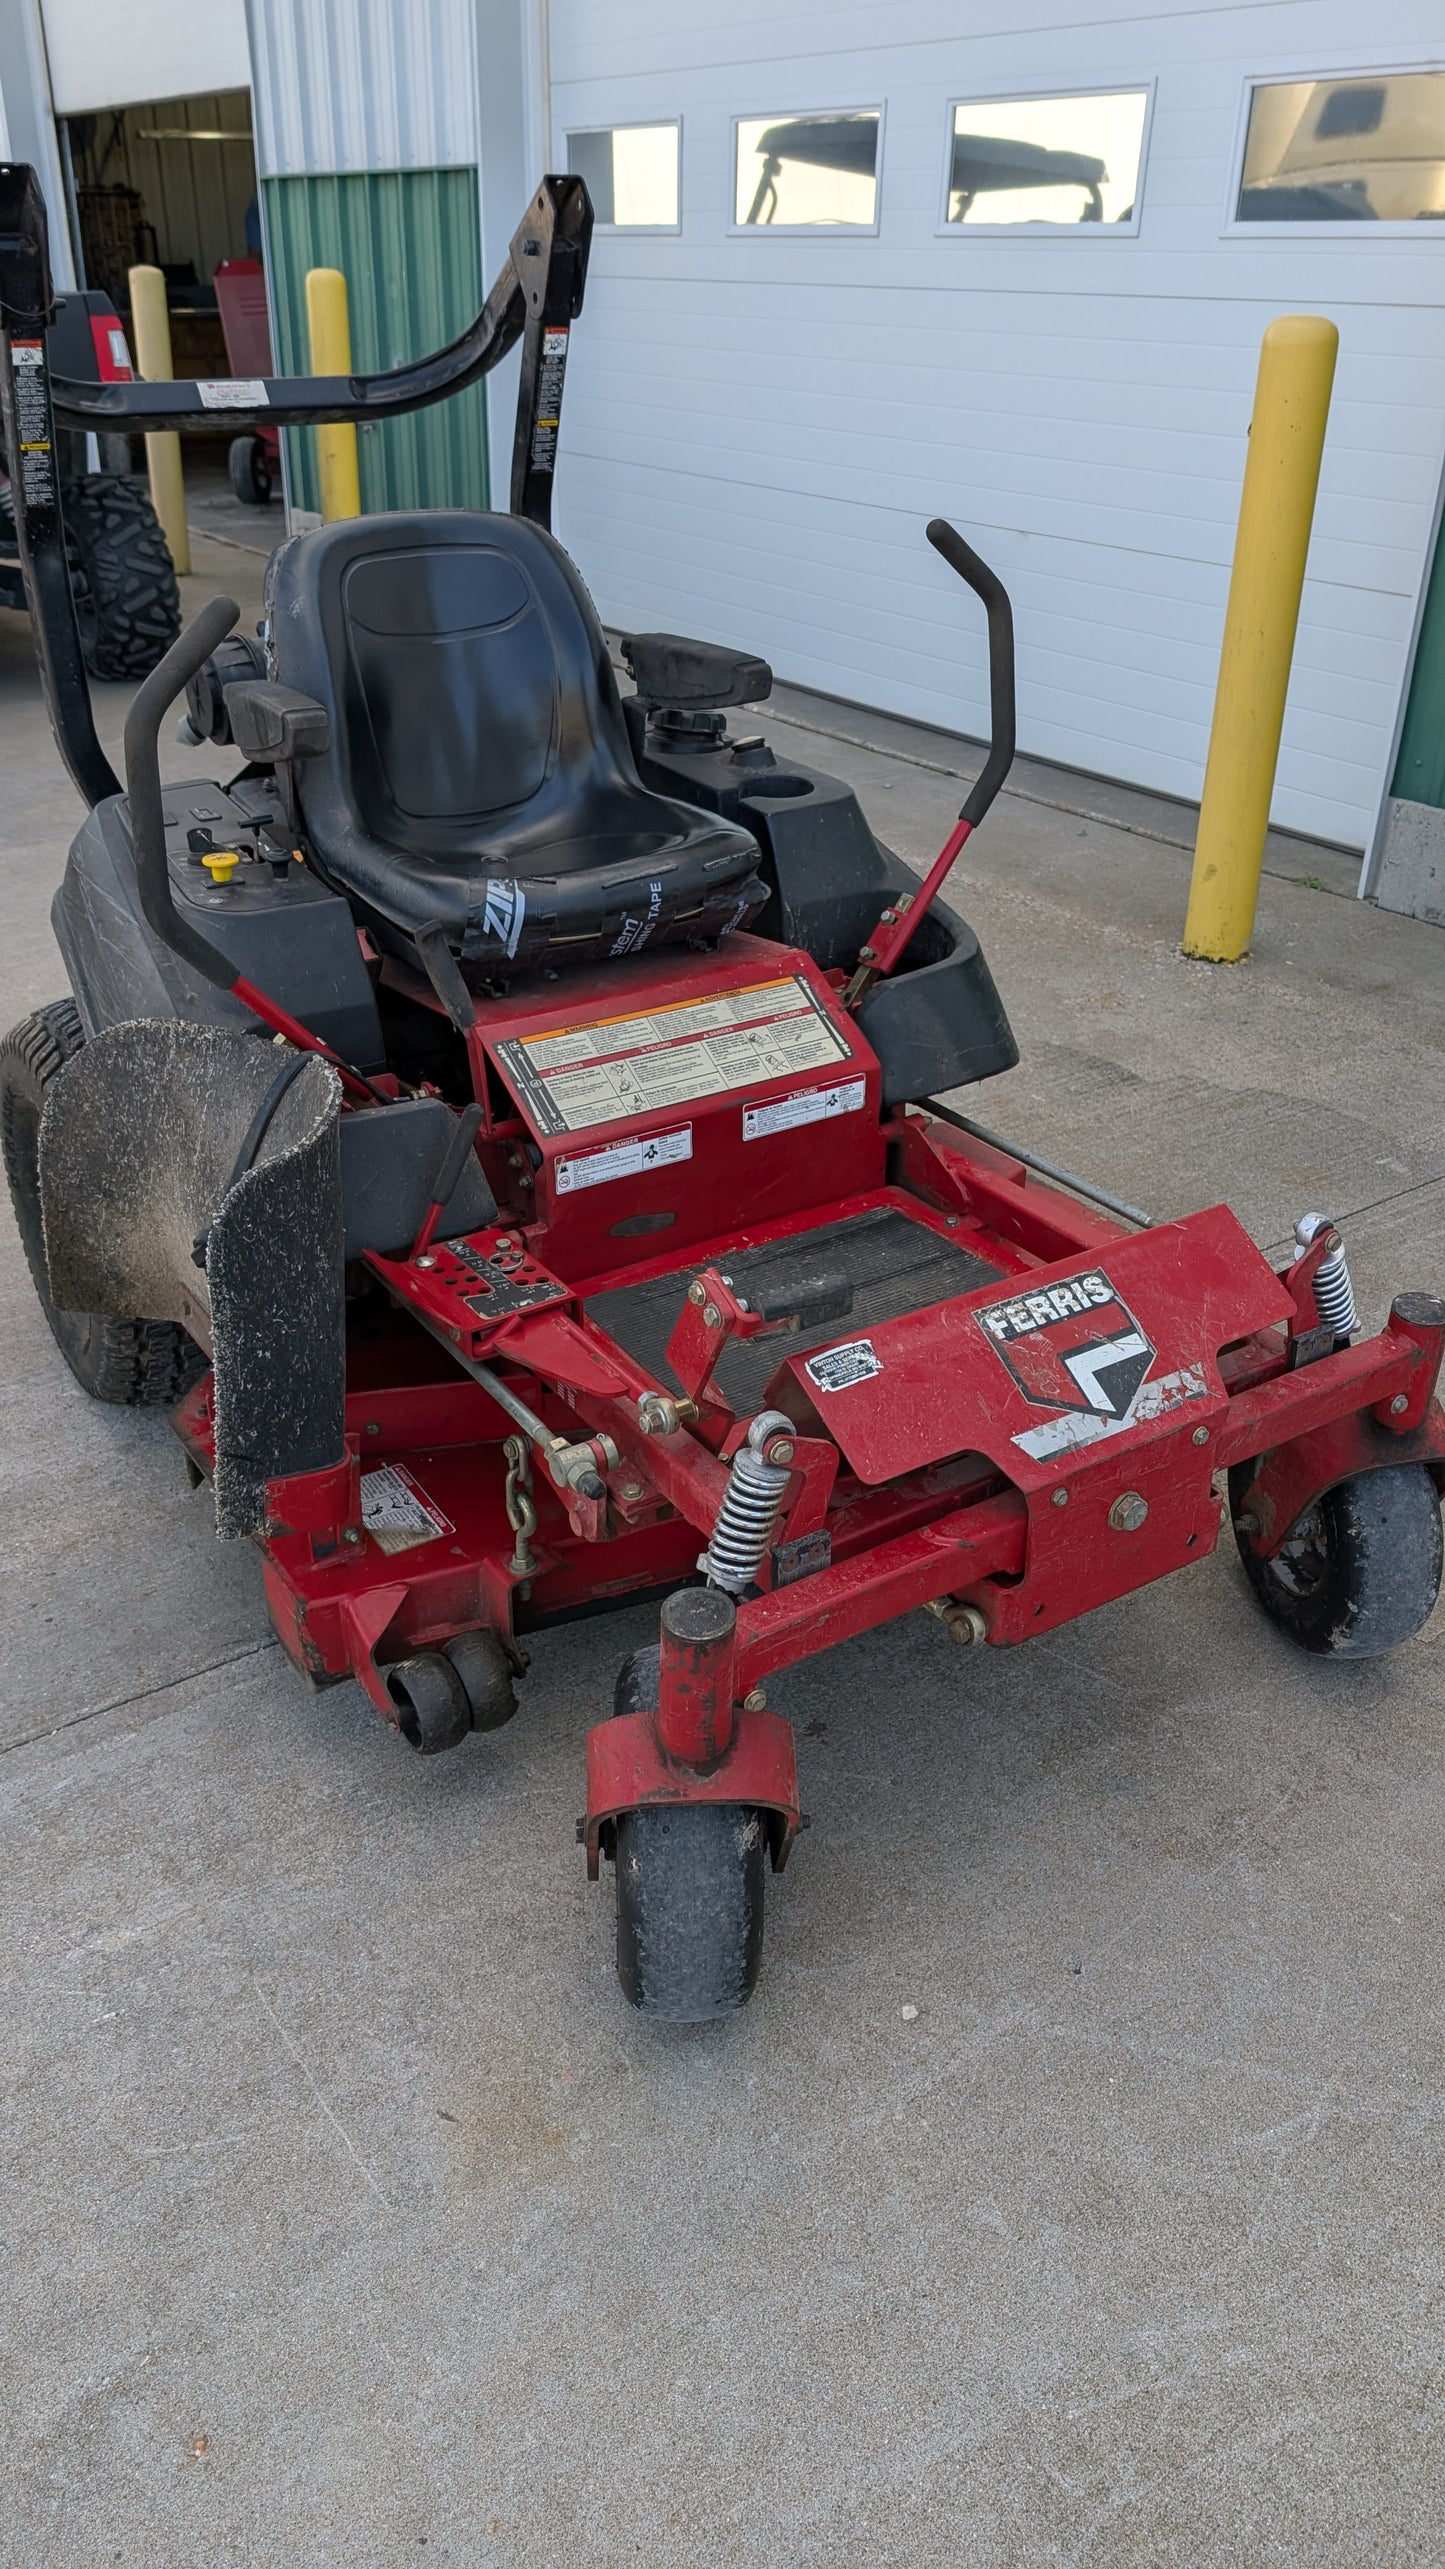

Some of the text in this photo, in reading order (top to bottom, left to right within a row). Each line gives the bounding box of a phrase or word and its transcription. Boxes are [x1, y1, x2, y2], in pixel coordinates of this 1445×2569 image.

[648, 881, 662, 919] TAPE
[482, 879, 514, 942] ZIP
[705, 989, 741, 1002] ADVERTENCIA
[778, 1010, 802, 1020] PELIGRO
[570, 1023, 598, 1033] WARNING
[708, 1027, 734, 1038] DANGER
[647, 1041, 672, 1053] PELIGRO
[556, 1062, 584, 1074] DANGER
[793, 1087, 818, 1099] PELIGRO
[612, 1137, 639, 1150] DANGER
[987, 1275, 1114, 1339] FERRIS
[833, 1349, 855, 1360] SUPPLY
[430, 1508, 447, 1528] PELIGRO
